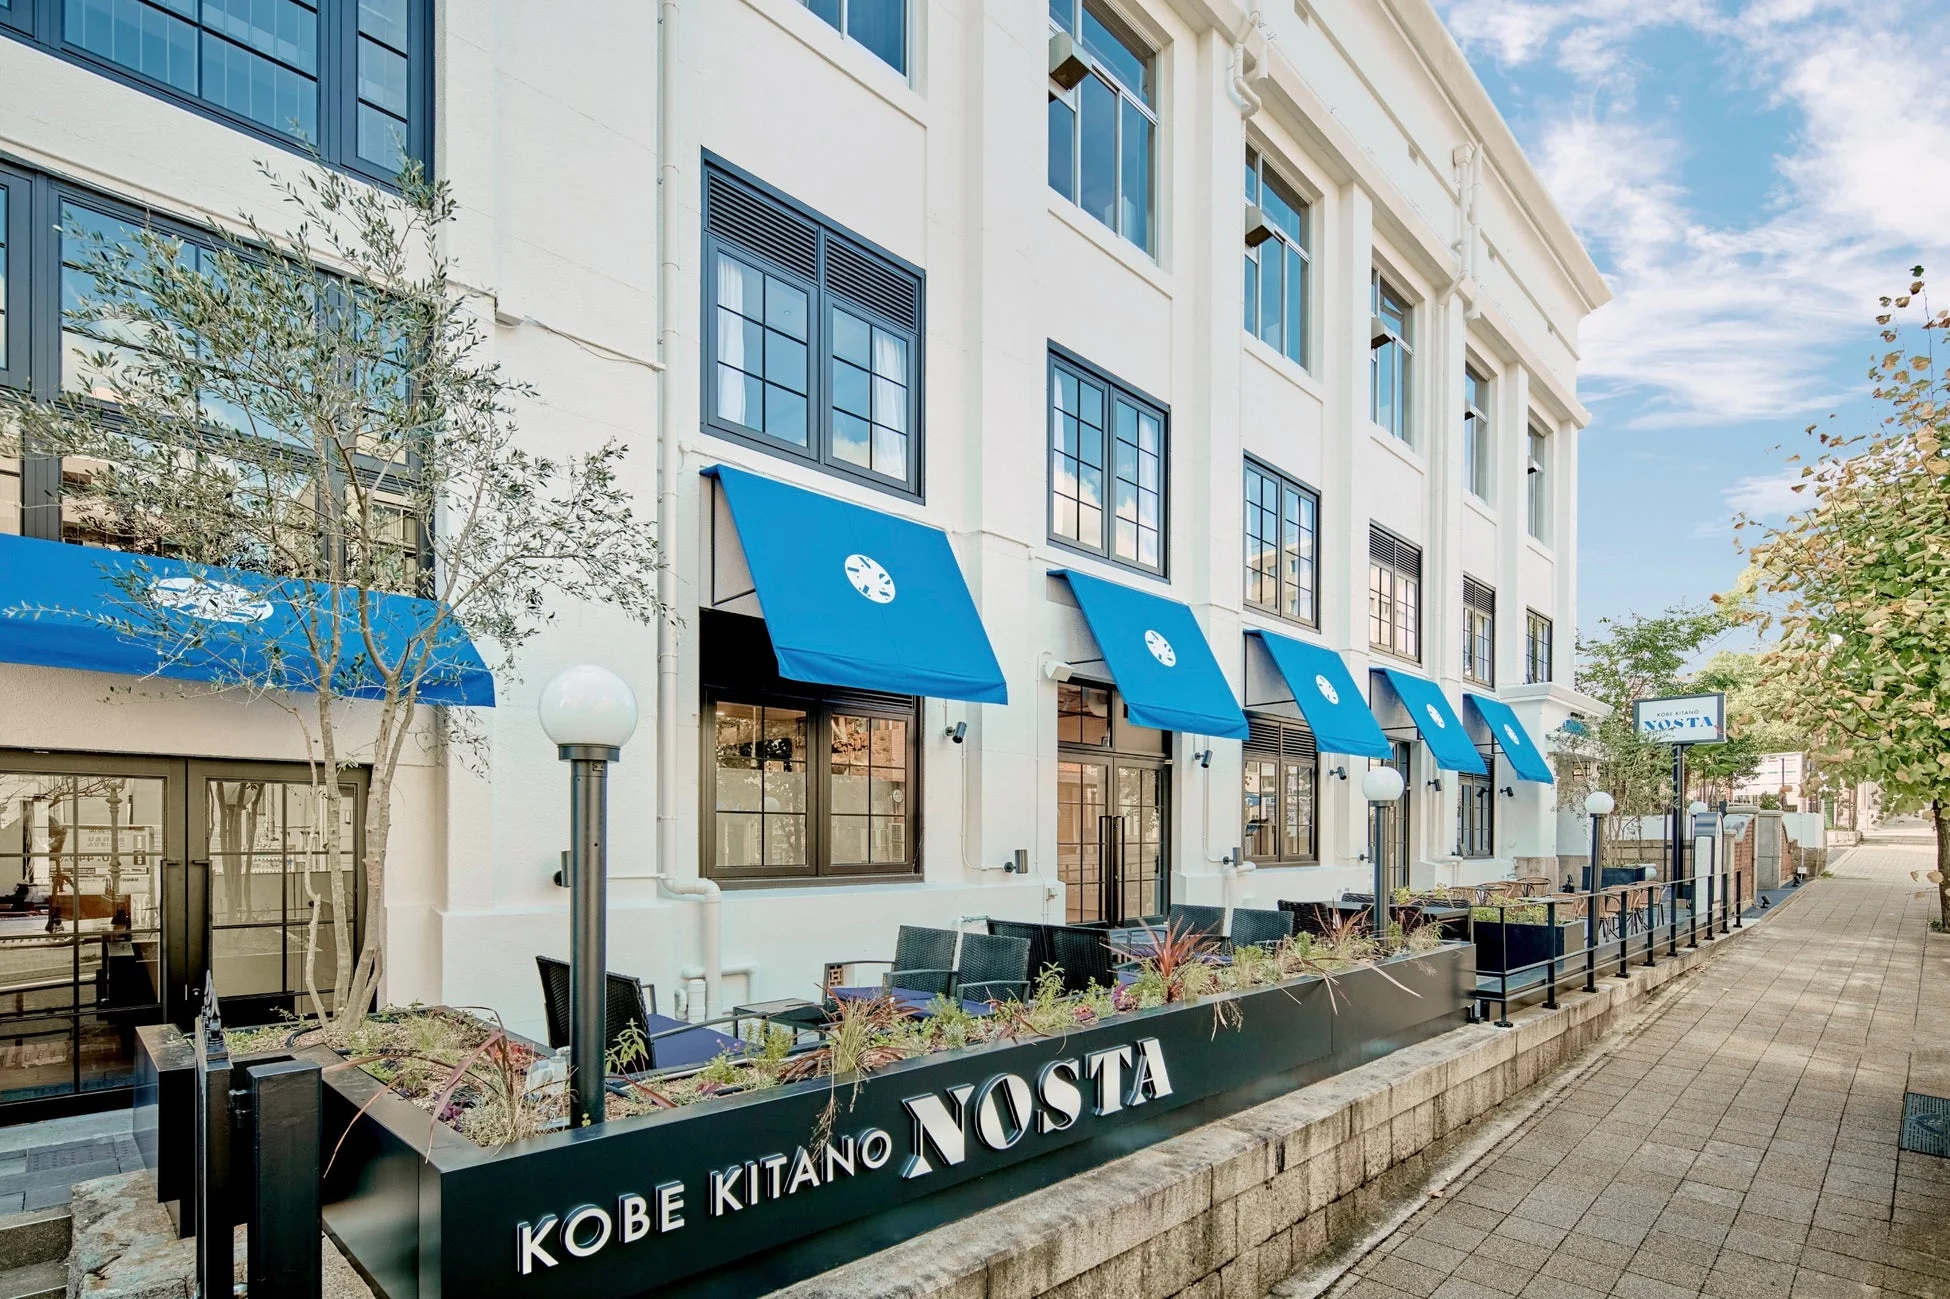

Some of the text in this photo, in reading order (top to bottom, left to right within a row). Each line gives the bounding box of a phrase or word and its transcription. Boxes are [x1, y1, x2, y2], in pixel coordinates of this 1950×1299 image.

[1644, 716, 1713, 731] NOSTA
[517, 1037, 1173, 1275] KOBE KITANO NOSTA
